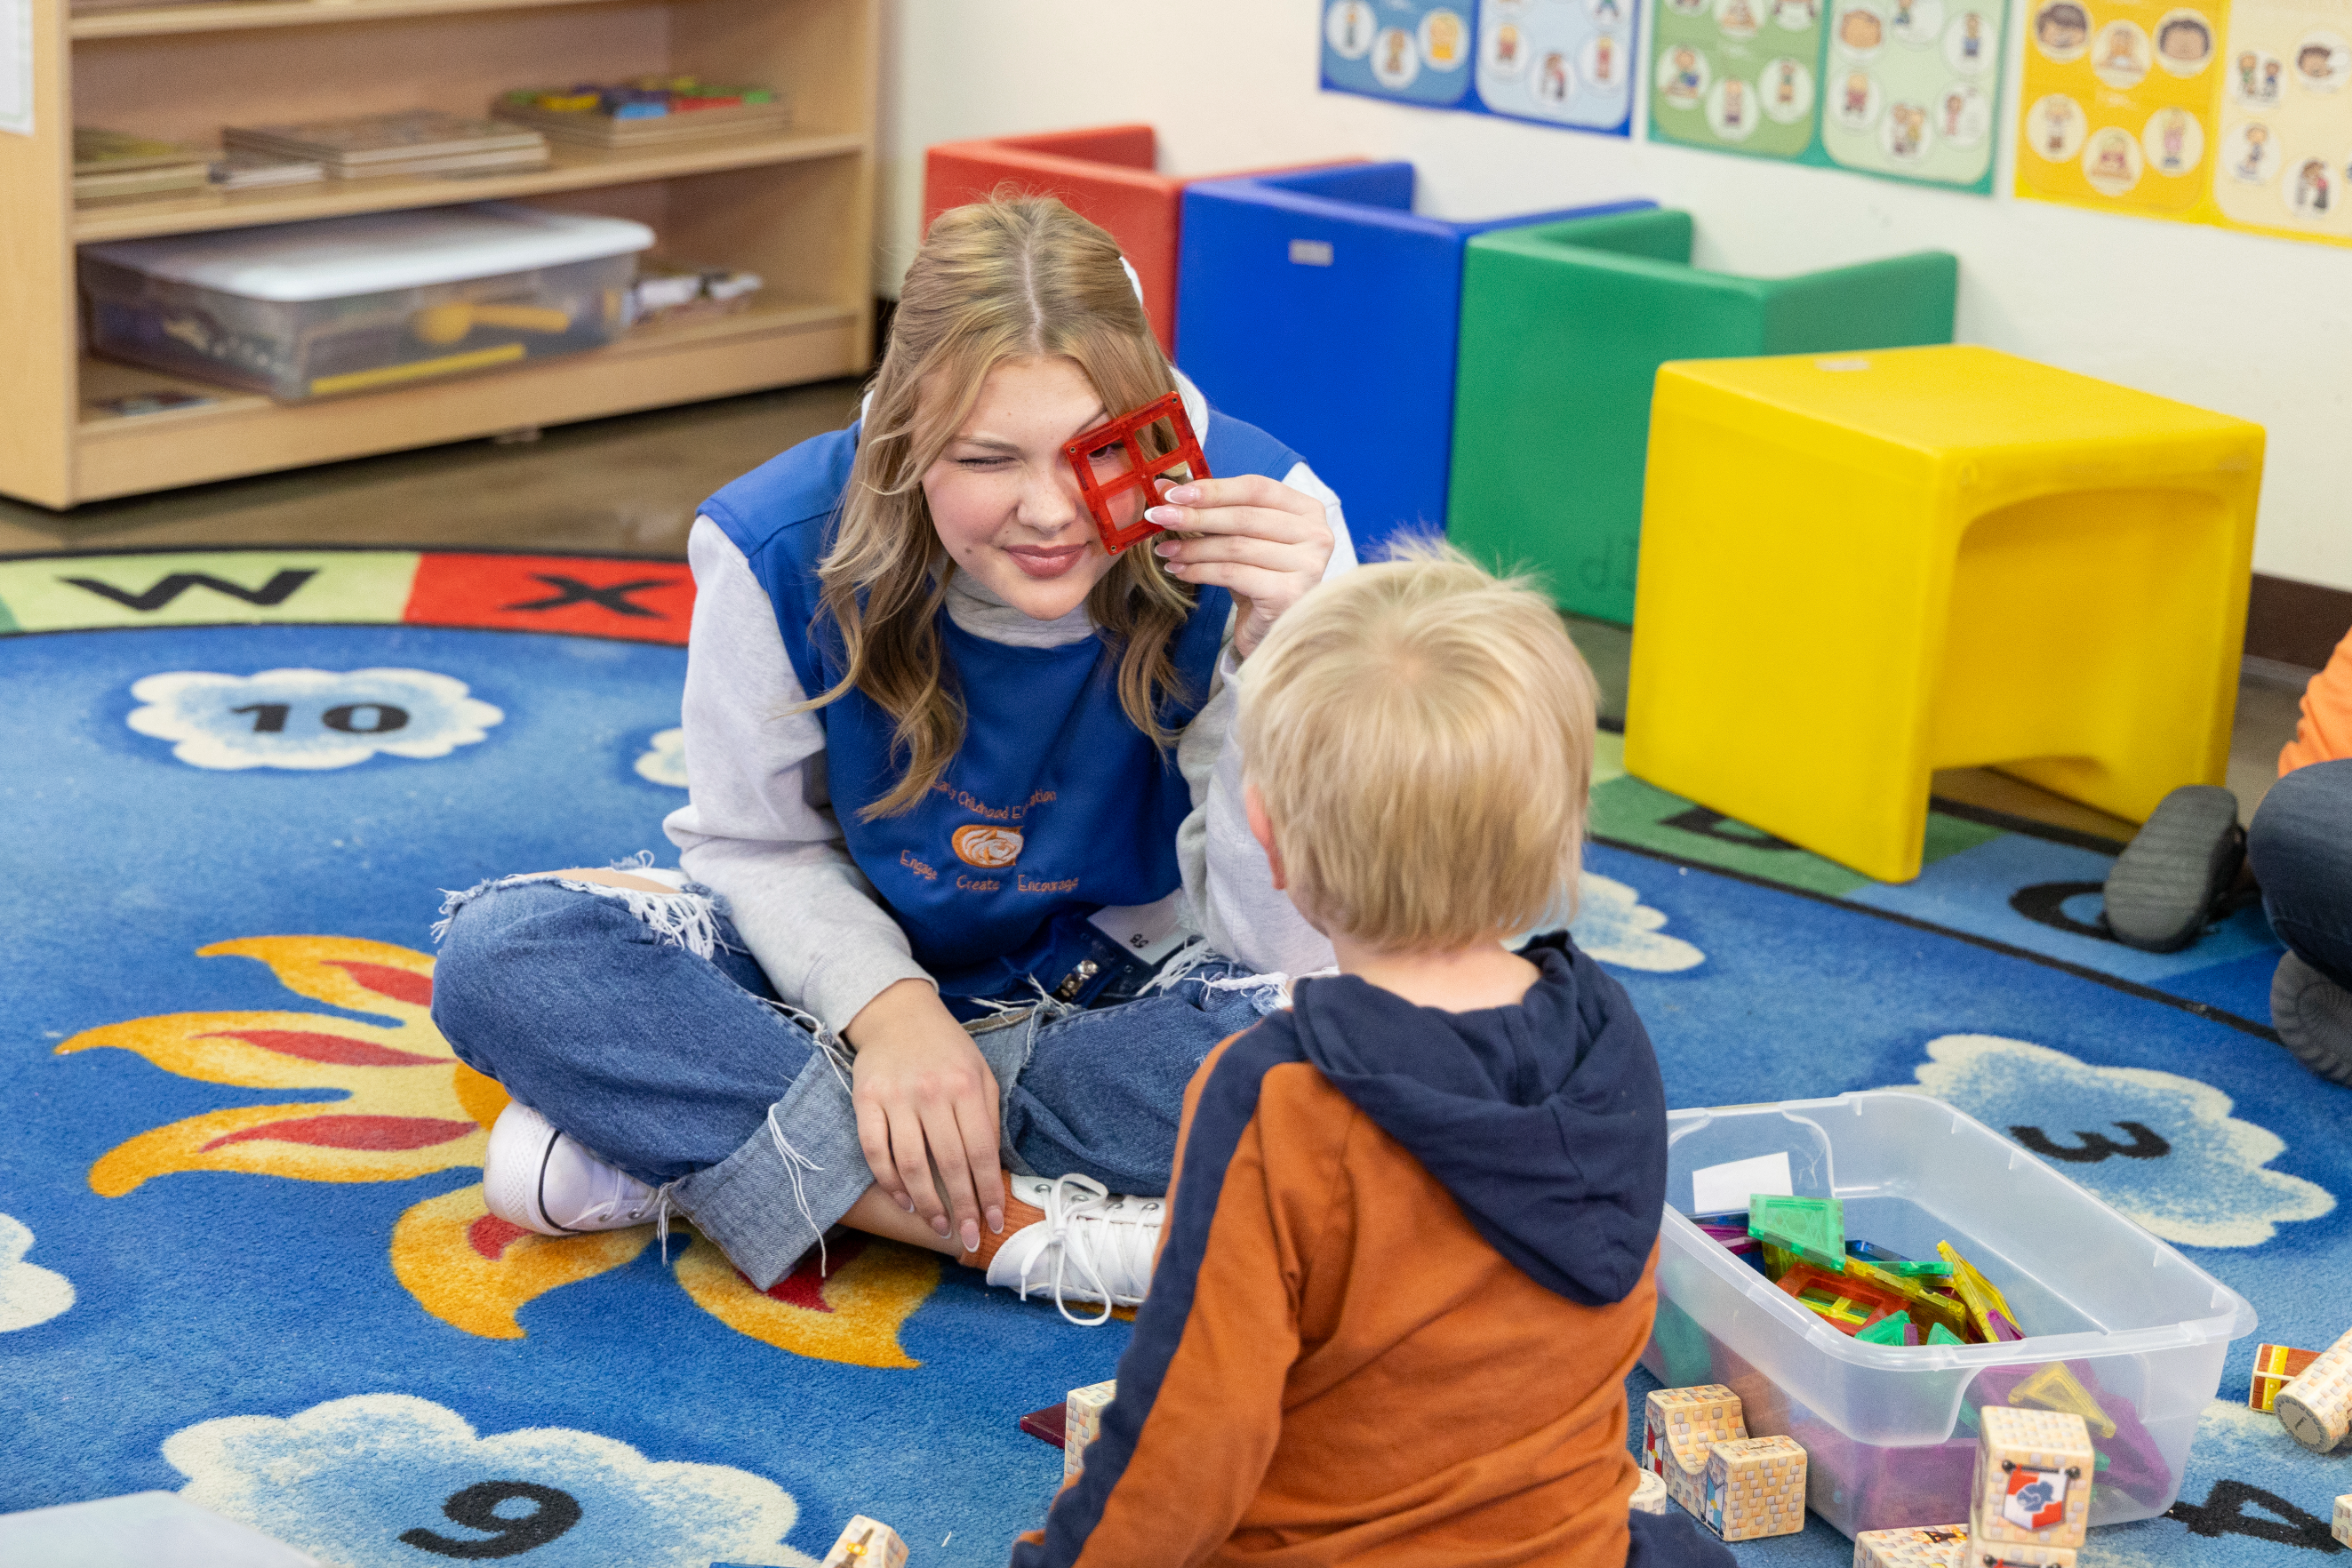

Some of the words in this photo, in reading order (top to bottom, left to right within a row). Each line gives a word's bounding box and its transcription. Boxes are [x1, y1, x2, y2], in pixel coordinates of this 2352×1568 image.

[59, 568, 320, 612] W
[500, 572, 684, 620] X
[230, 700, 412, 734] 10
[900, 849, 938, 880] Engage
[956, 875, 1001, 892] Create
[1017, 874, 1079, 892] Encourage
[2009, 1119, 2171, 1163] 3
